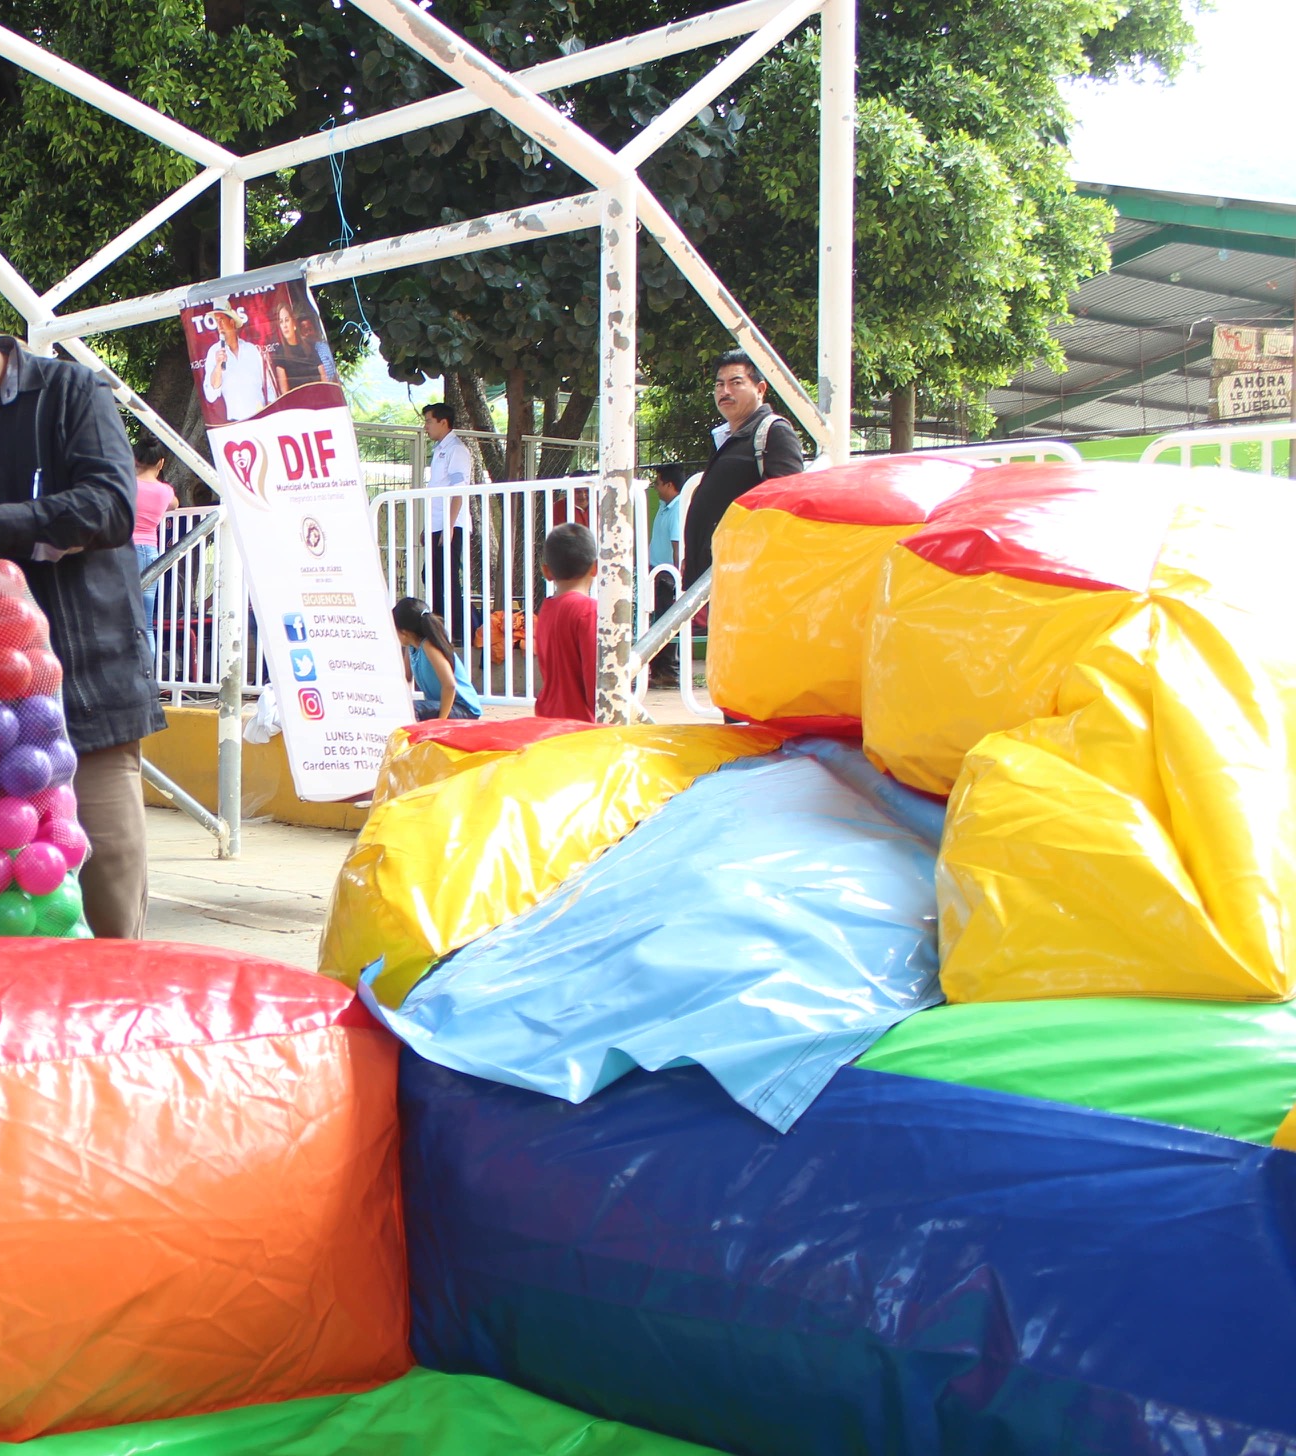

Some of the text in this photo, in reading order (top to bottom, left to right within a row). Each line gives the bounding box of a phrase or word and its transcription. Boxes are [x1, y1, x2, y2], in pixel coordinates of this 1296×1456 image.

[1233, 375, 1286, 389] AHORA
[1230, 391, 1243, 400] LE
[1248, 389, 1273, 399] TOCA
[1232, 397, 1287, 413] PUEBLO
[277, 429, 336, 481] DIF
[276, 482, 302, 492] Municipal
[311, 480, 331, 489] Oaxaca
[313, 614, 366, 625] DIF MUNICIPAL
[309, 628, 379, 640] OAXACA DE JUÁREZ
[332, 691, 384, 704] DIF MUNICIPAL
[348, 705, 376, 717] OAXACA
[325, 732, 388, 744] LUNES A VIERNE
[324, 746, 337, 756] DE
[361, 746, 367, 755] A
[303, 760, 350, 771] Gardenias
